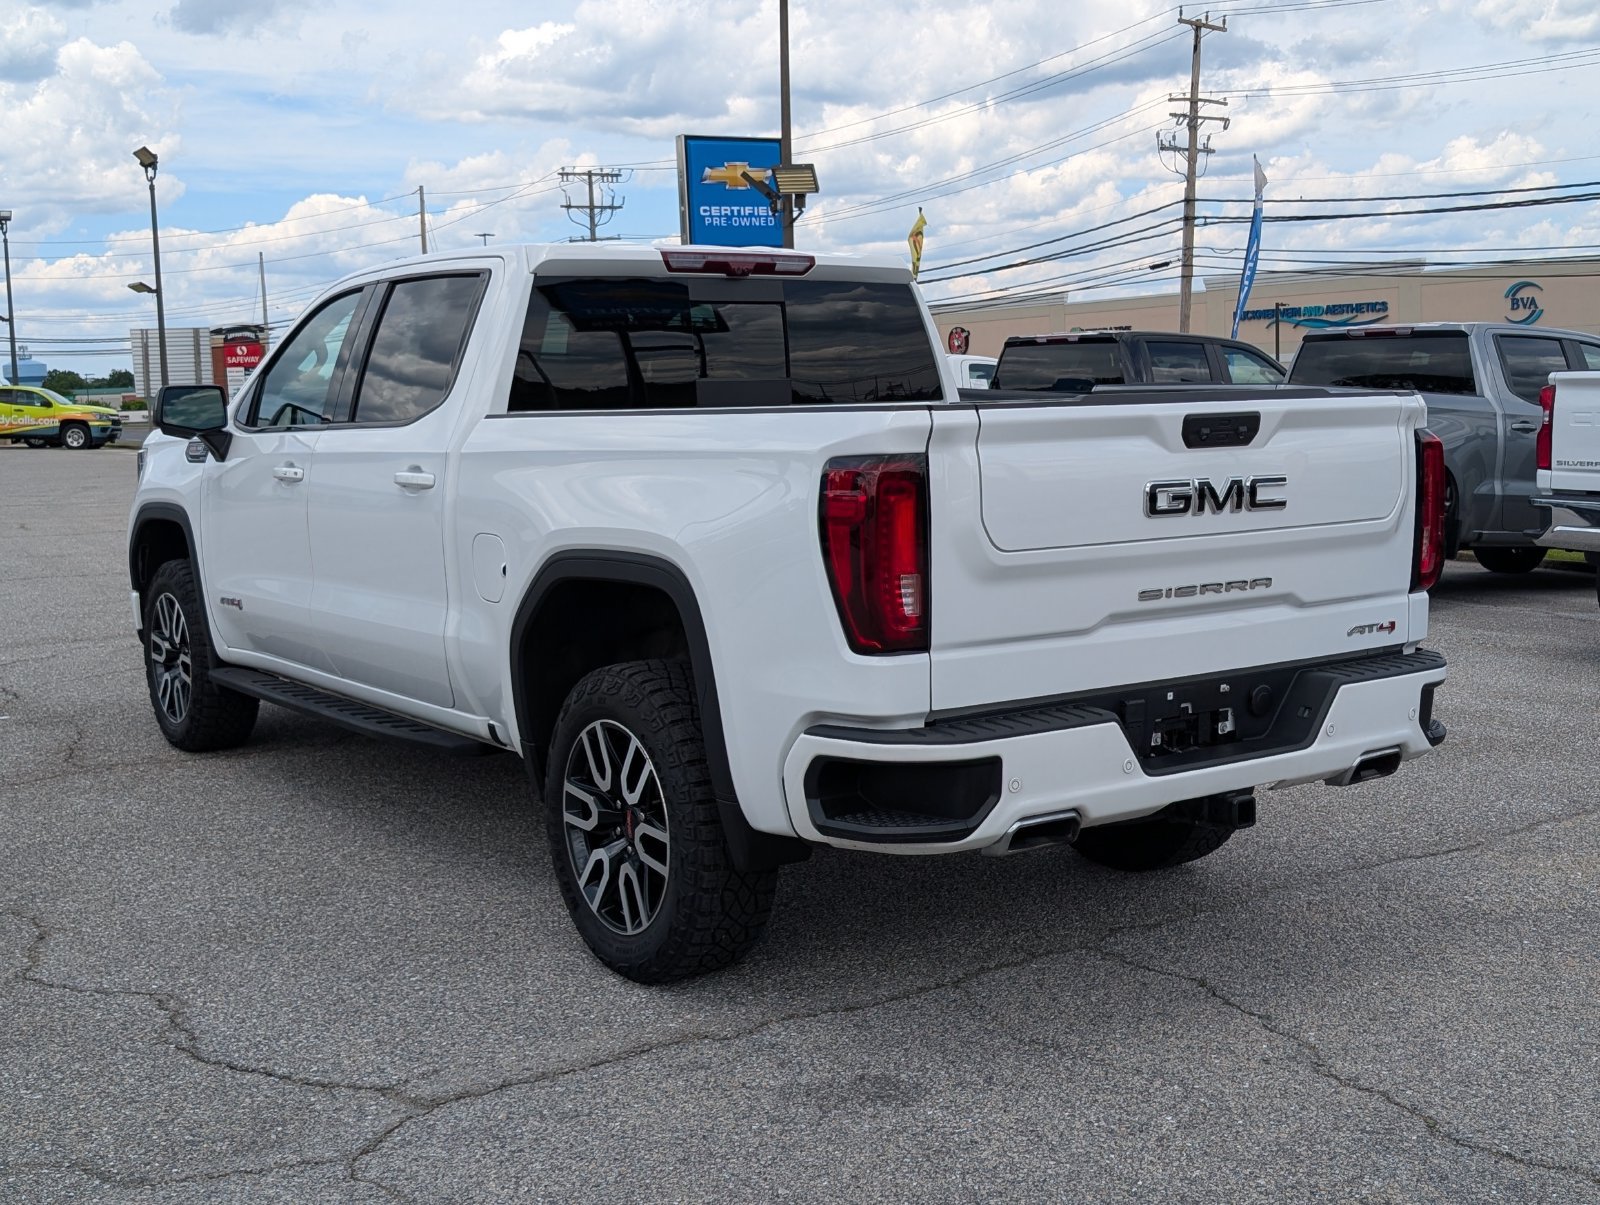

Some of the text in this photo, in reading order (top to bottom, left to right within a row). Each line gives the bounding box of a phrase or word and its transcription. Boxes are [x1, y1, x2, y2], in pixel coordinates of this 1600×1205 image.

[705, 217, 775, 226] PRE-OWNED
[1302, 305, 1325, 317] AND
[1325, 301, 1389, 316] AESTHETICS
[1511, 296, 1539, 310] BVA
[227, 356, 260, 364] SAFEWAY
[1143, 474, 1288, 519] GMC
[1138, 577, 1273, 601] SIERRA
[1347, 620, 1396, 637] AT4
